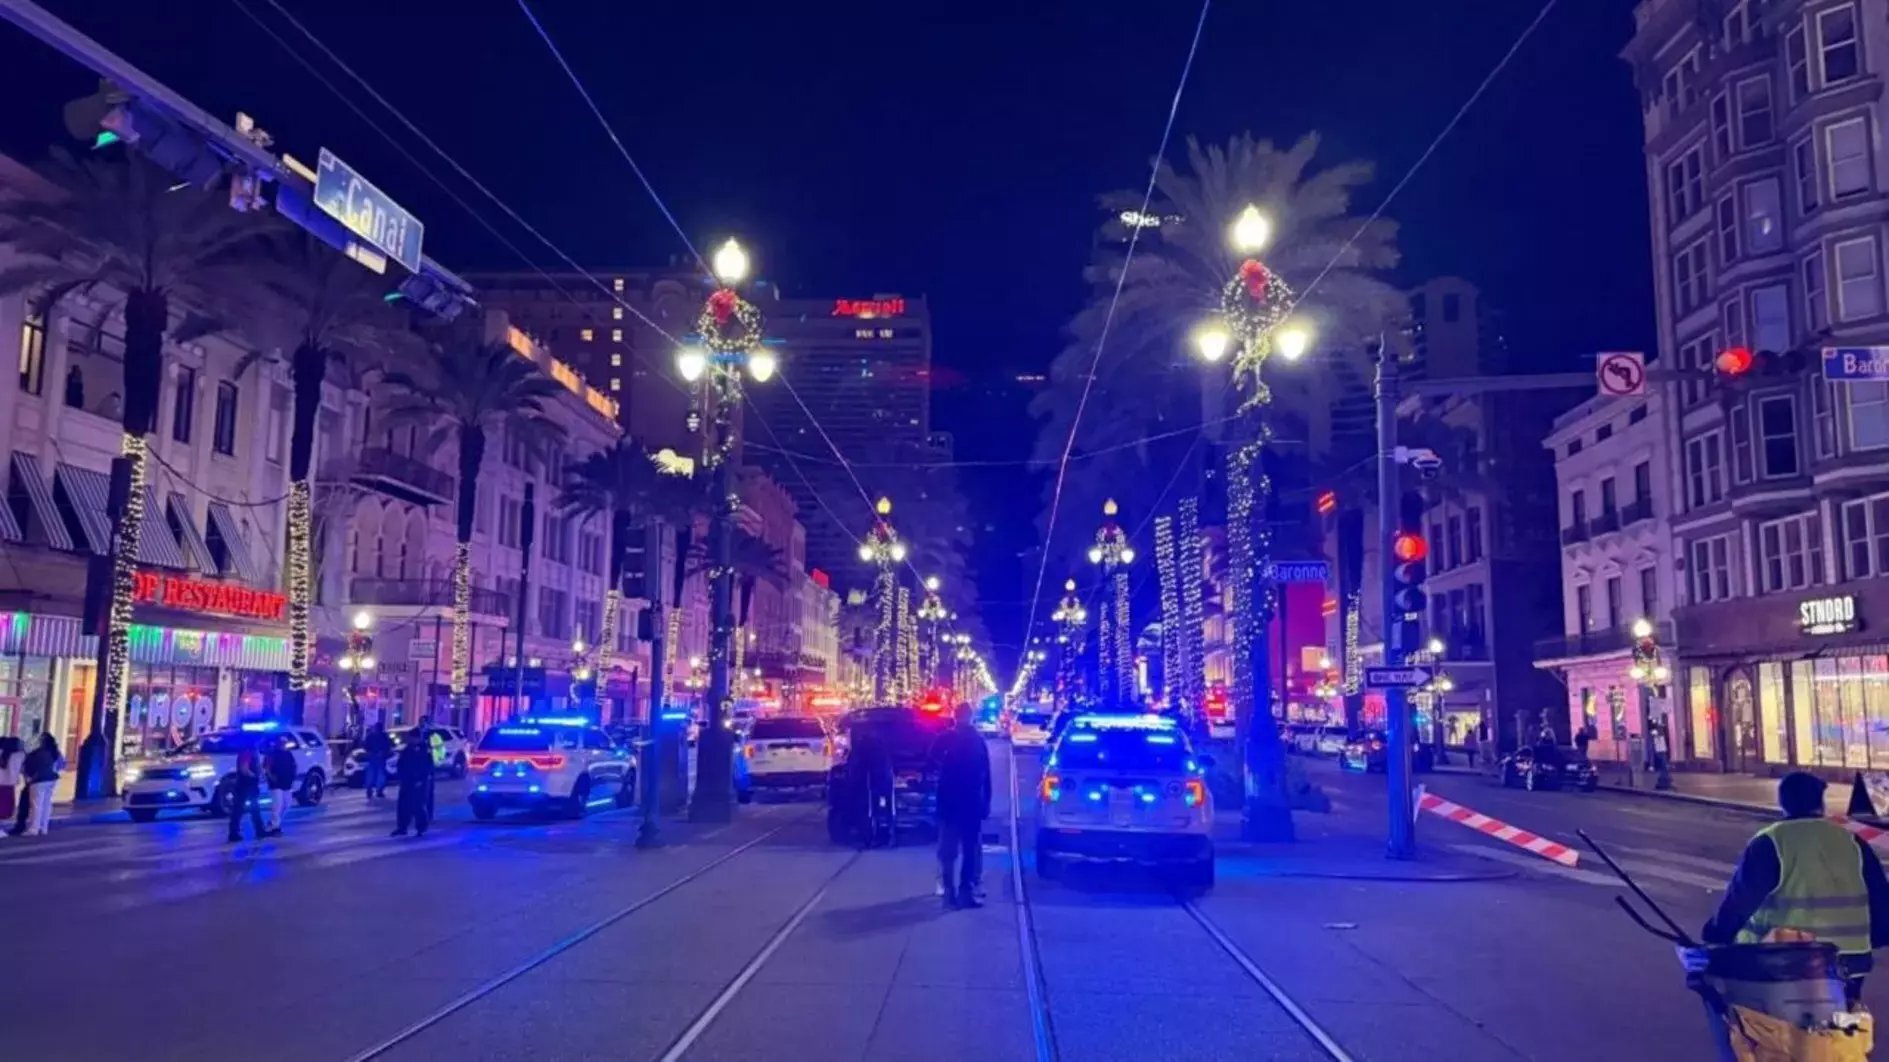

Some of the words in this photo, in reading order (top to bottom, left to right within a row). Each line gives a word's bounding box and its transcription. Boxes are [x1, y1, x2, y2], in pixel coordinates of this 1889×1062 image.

[346, 178, 407, 257] Canal
[1269, 564, 1327, 580] Baronne
[164, 577, 285, 619] RESTAURANT
[1800, 596, 1855, 625] STNDRD
